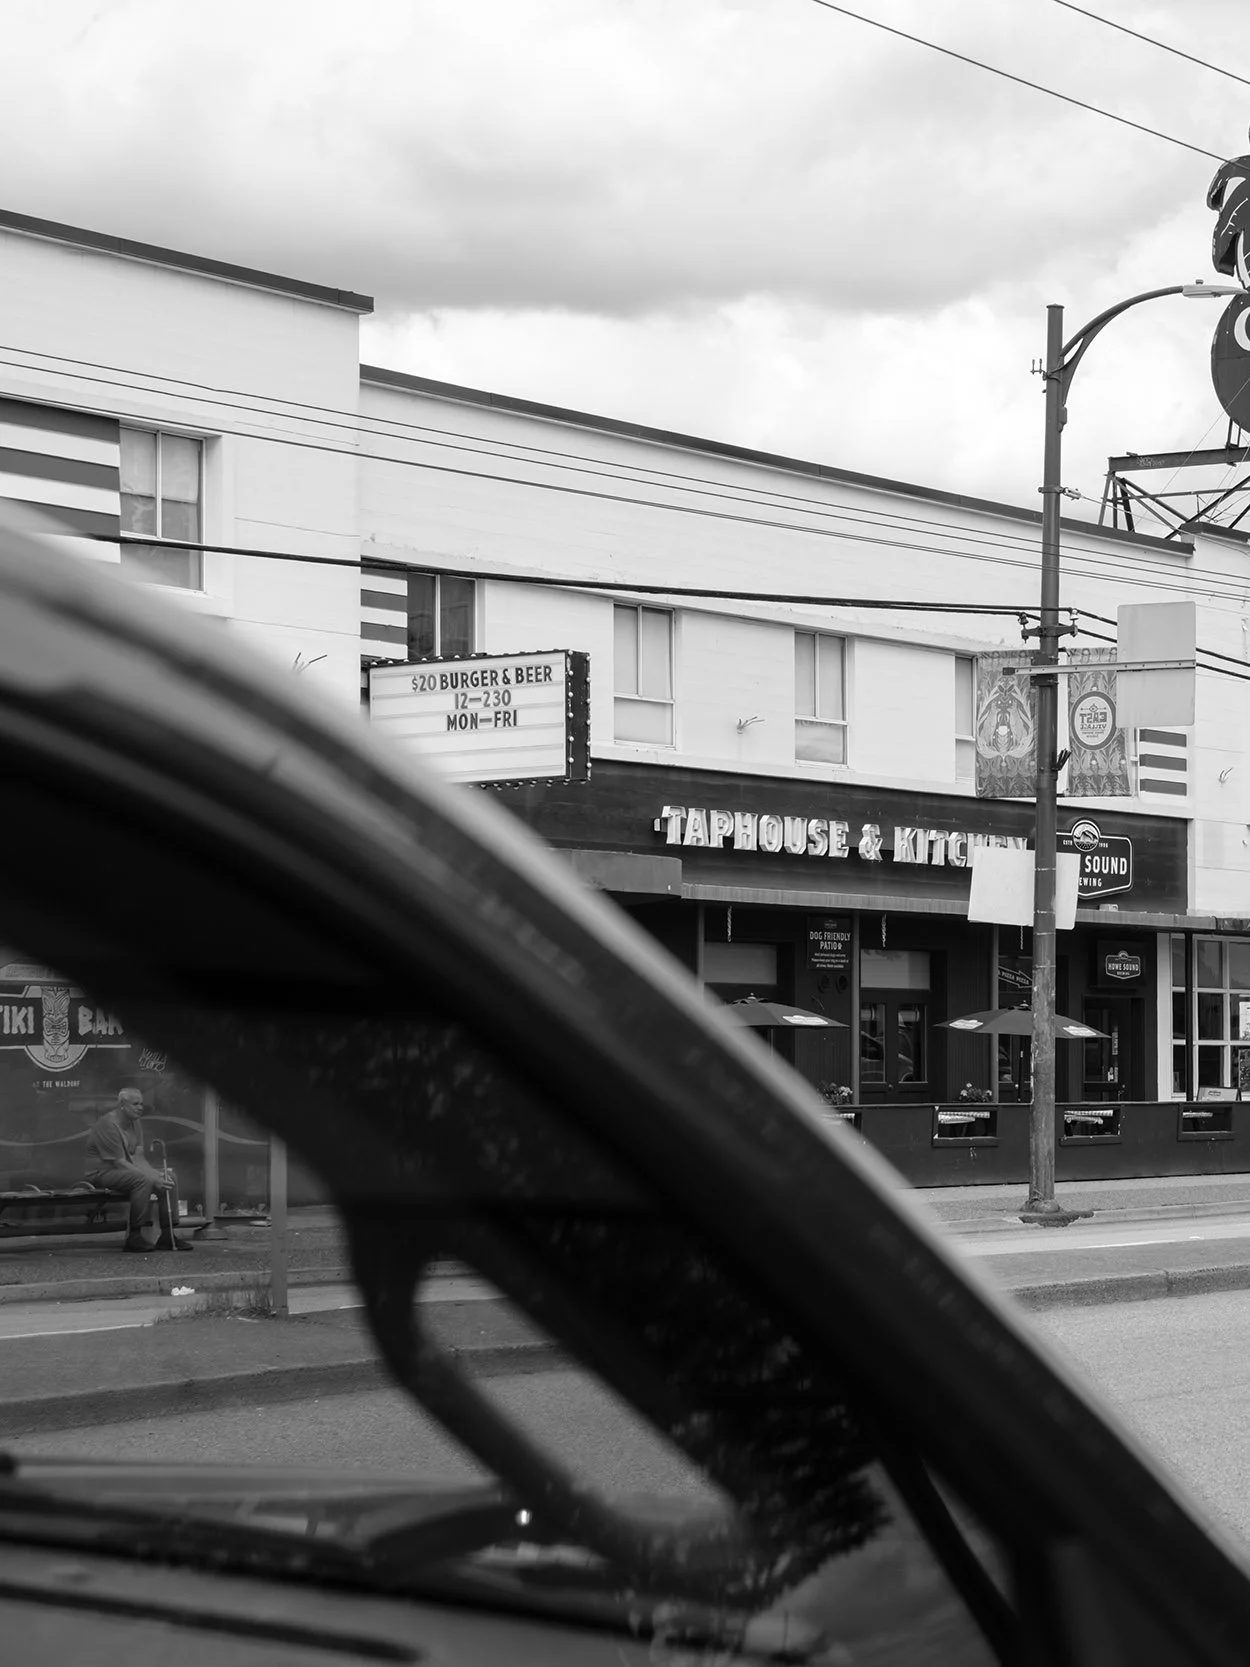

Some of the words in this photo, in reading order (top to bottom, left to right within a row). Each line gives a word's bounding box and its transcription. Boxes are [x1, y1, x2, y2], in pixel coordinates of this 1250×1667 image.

[411, 674, 437, 692] $20
[440, 669, 499, 690] BURGER
[502, 668, 511, 685] &
[515, 665, 553, 684] BEER
[661, 804, 850, 859] TAPHOUSE
[858, 823, 883, 861] &
[1084, 855, 1128, 875] SOUND
[1079, 877, 1102, 887] EWING
[810, 931, 823, 940] DOG
